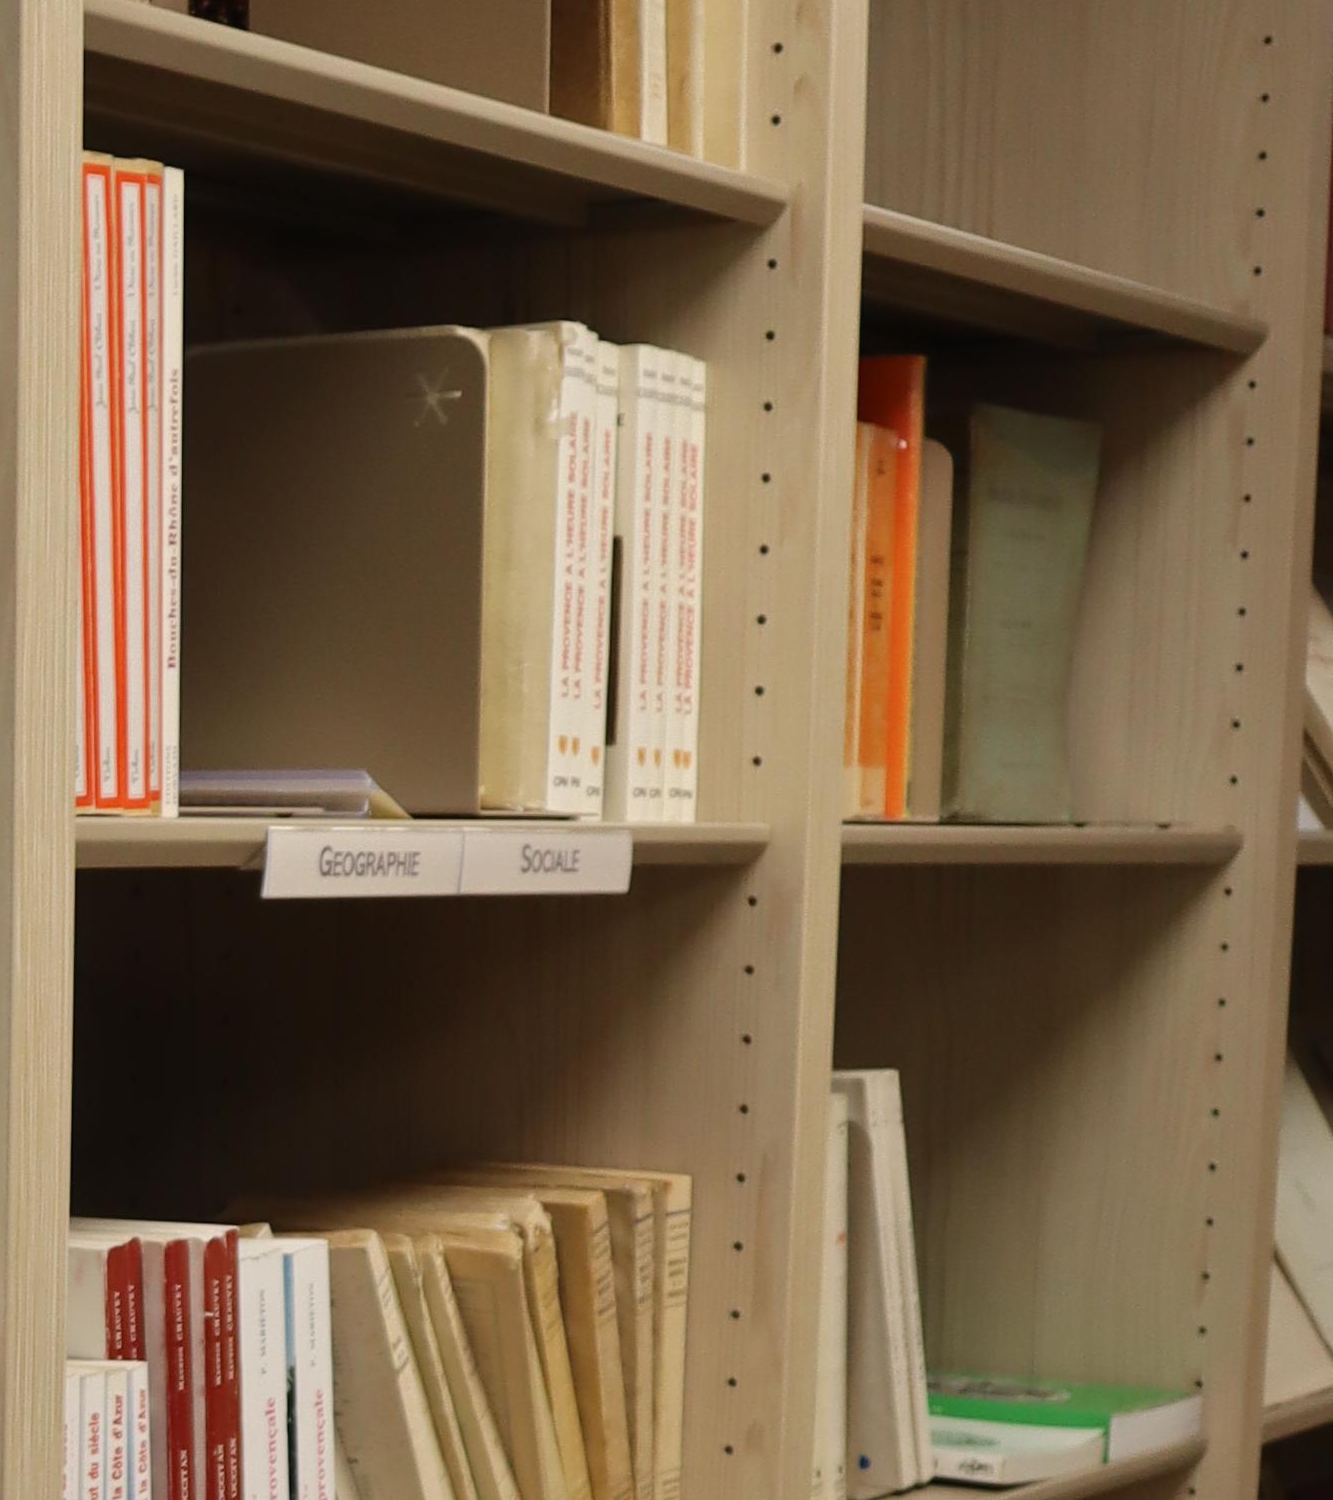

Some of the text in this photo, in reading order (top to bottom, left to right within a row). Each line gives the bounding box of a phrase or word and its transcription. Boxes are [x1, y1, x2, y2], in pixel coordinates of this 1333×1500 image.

[521, 843, 580, 874] SOCIALE
[87, 1413, 101, 1454] siècle
[87, 1461, 101, 1479] du
